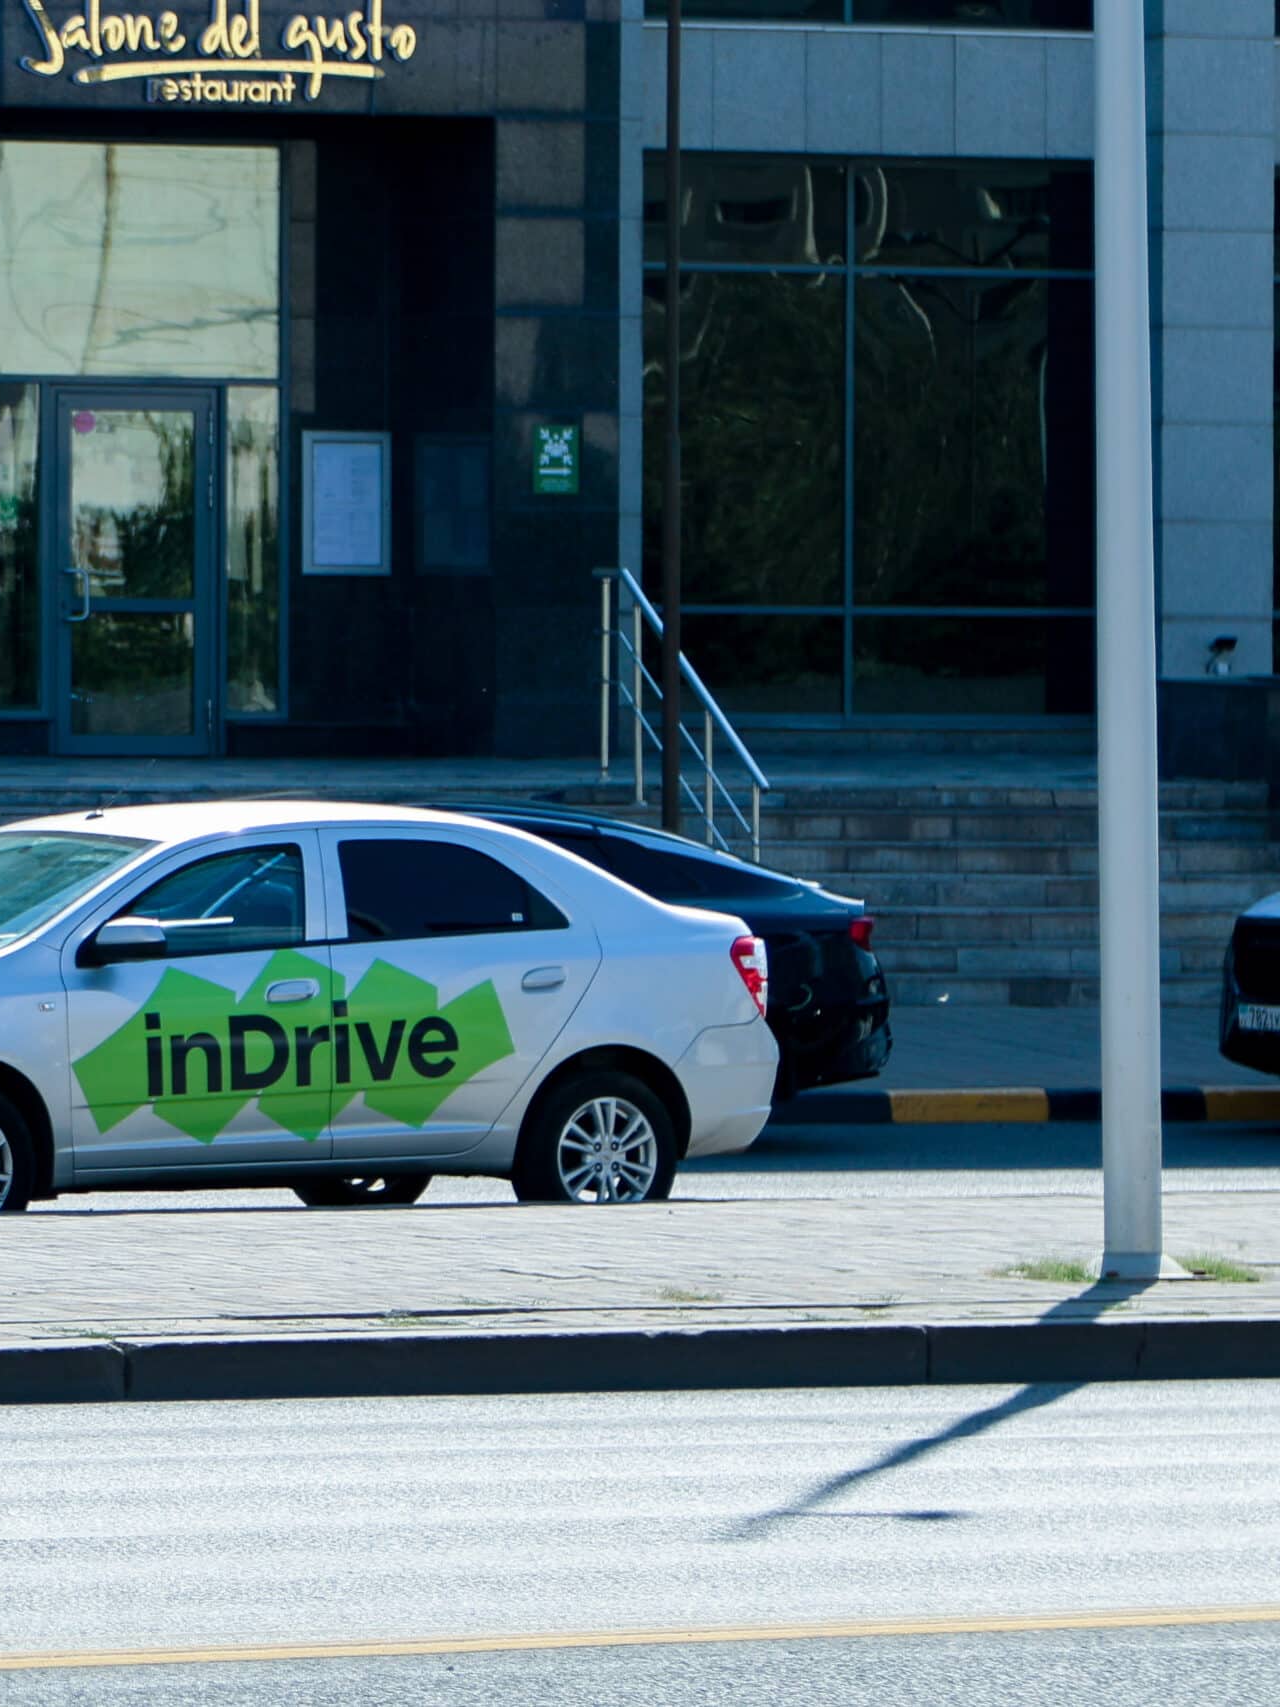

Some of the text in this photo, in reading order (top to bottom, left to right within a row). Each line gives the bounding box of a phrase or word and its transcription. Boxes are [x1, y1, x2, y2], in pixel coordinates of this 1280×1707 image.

[146, 72, 297, 103] restaurant
[197, 0, 261, 58] del
[282, 0, 417, 100] gusto
[145, 1000, 459, 1097] inDrive
